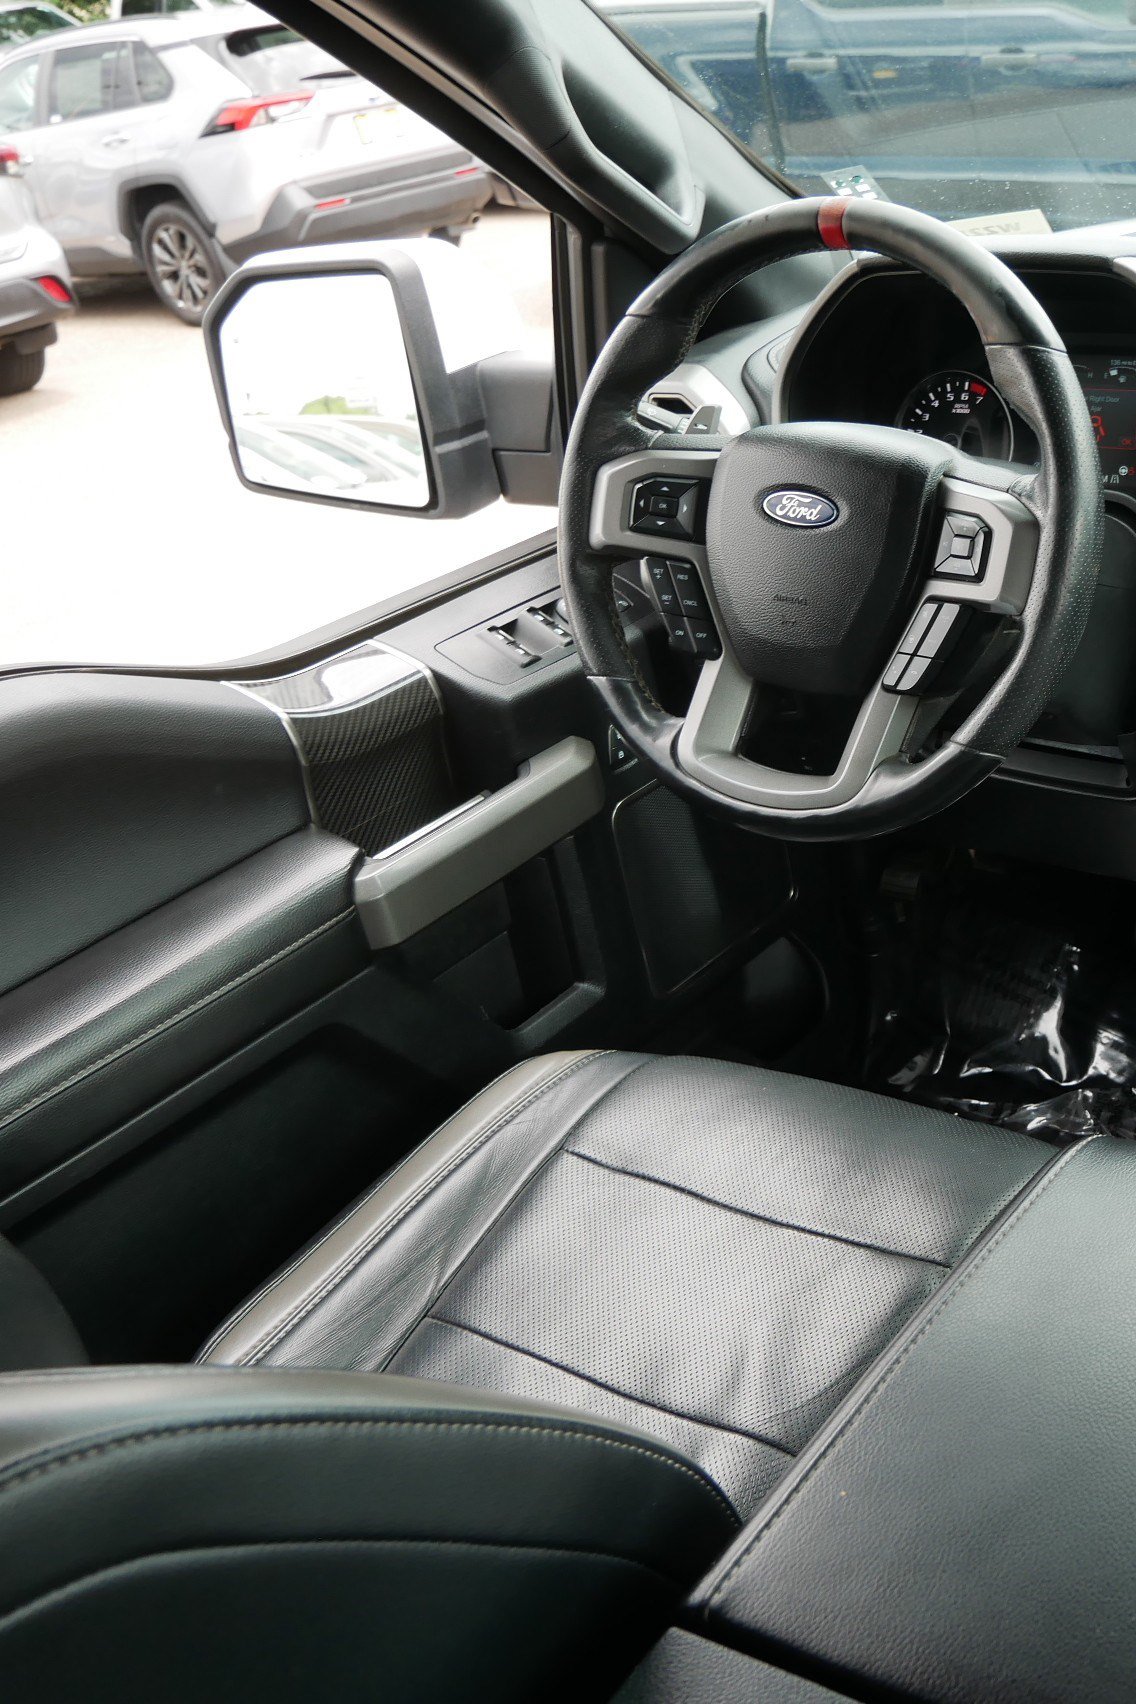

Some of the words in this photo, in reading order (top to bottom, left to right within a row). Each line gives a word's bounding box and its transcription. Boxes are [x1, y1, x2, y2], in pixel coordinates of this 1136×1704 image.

[947, 393, 955, 401] 5
[961, 393, 969, 401] 6
[976, 396, 984, 405] 7
[931, 400, 940, 408] 4
[922, 413, 930, 421] 3
[776, 494, 822, 521] Ford
[677, 573, 688, 581] RES
